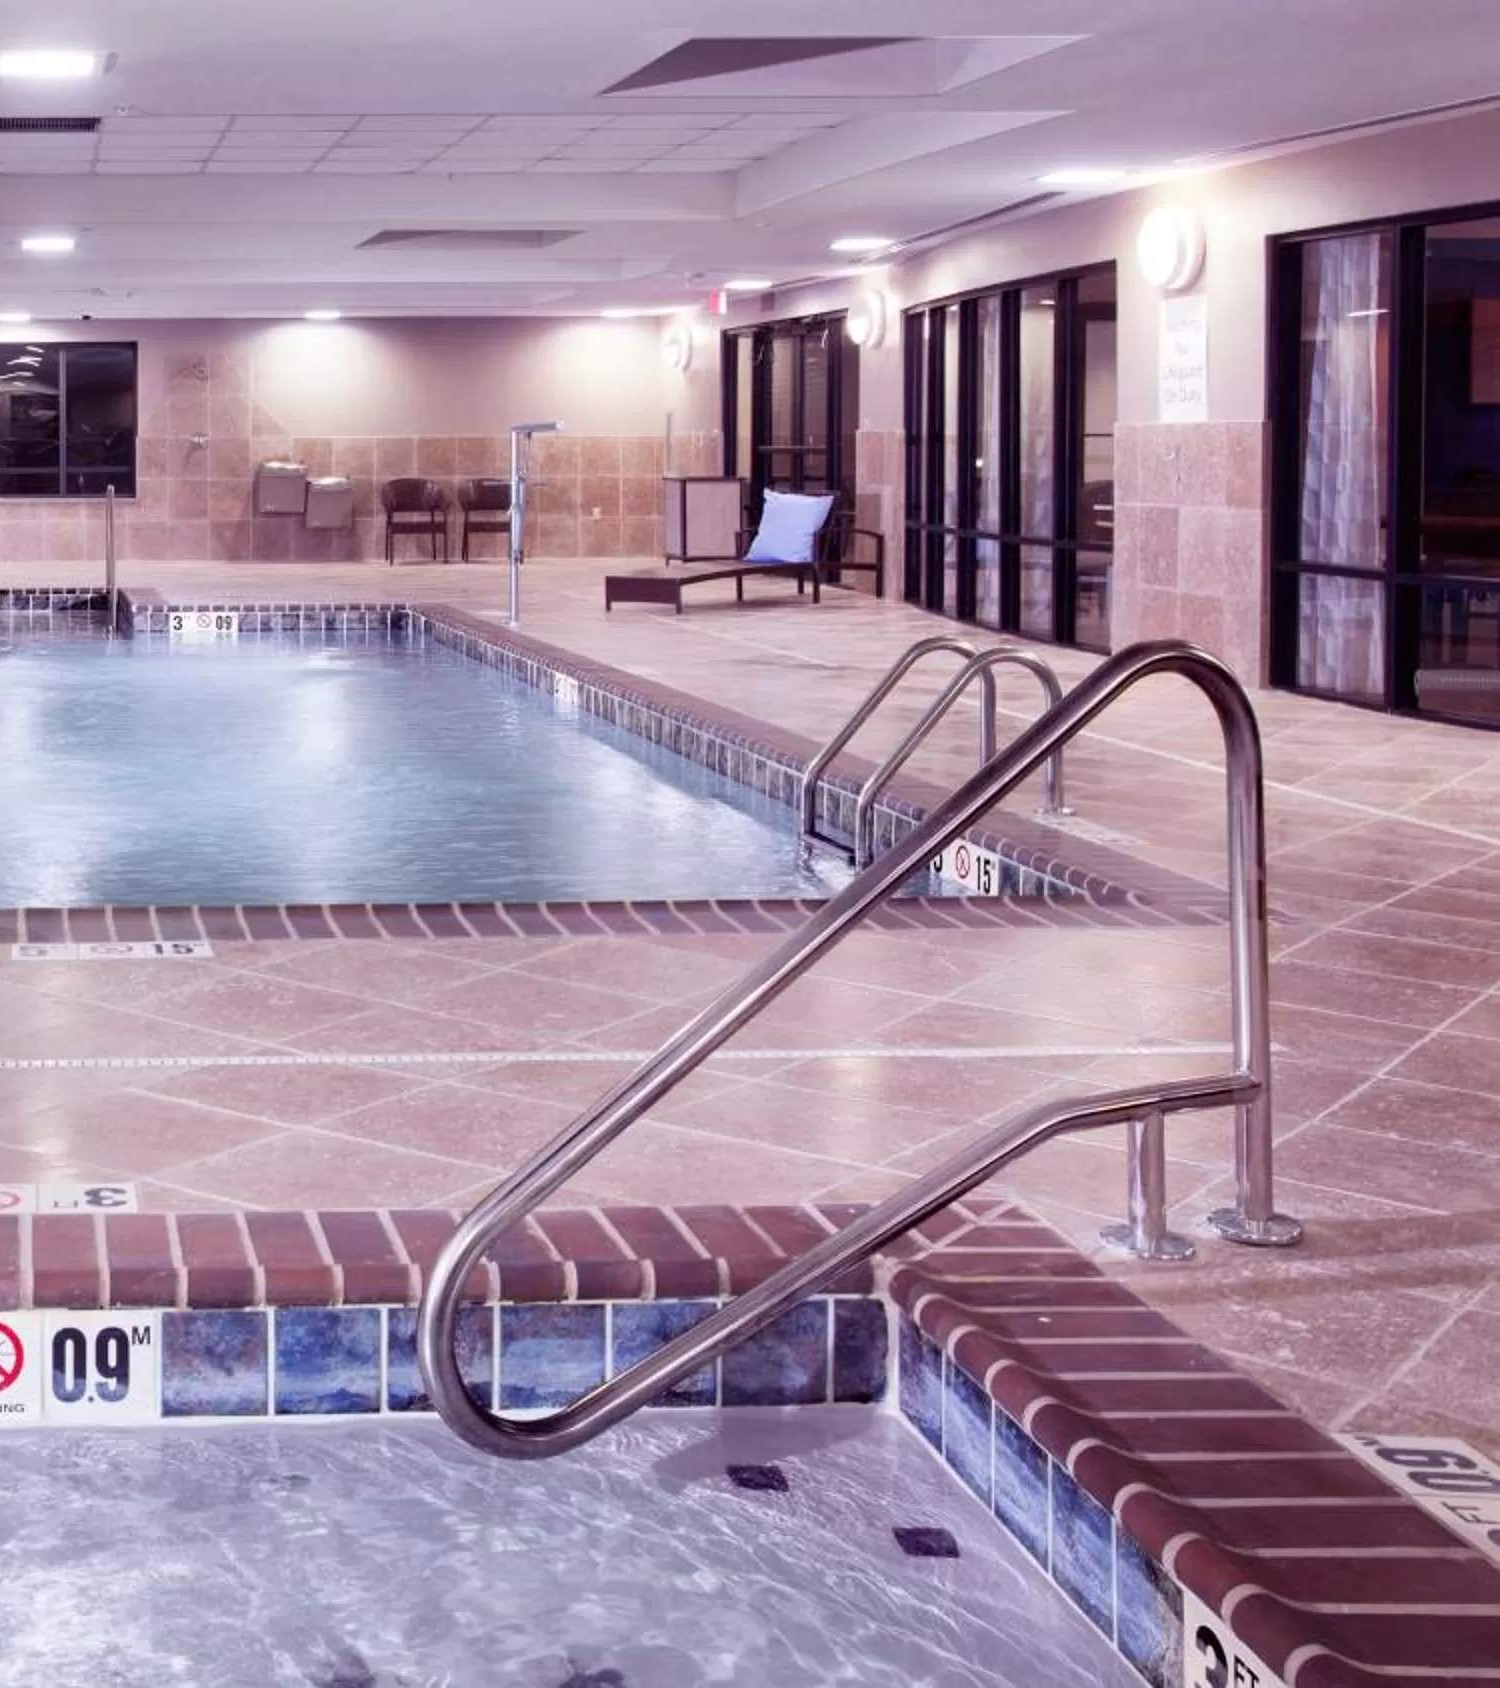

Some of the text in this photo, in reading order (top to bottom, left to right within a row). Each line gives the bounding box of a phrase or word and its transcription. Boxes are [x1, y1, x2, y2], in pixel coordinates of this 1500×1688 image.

[173, 615, 183, 631] 3
[975, 855, 992, 894] 15
[154, 943, 194, 955] 15
[79, 1187, 128, 1208] 3
[130, 1325, 152, 1346] M
